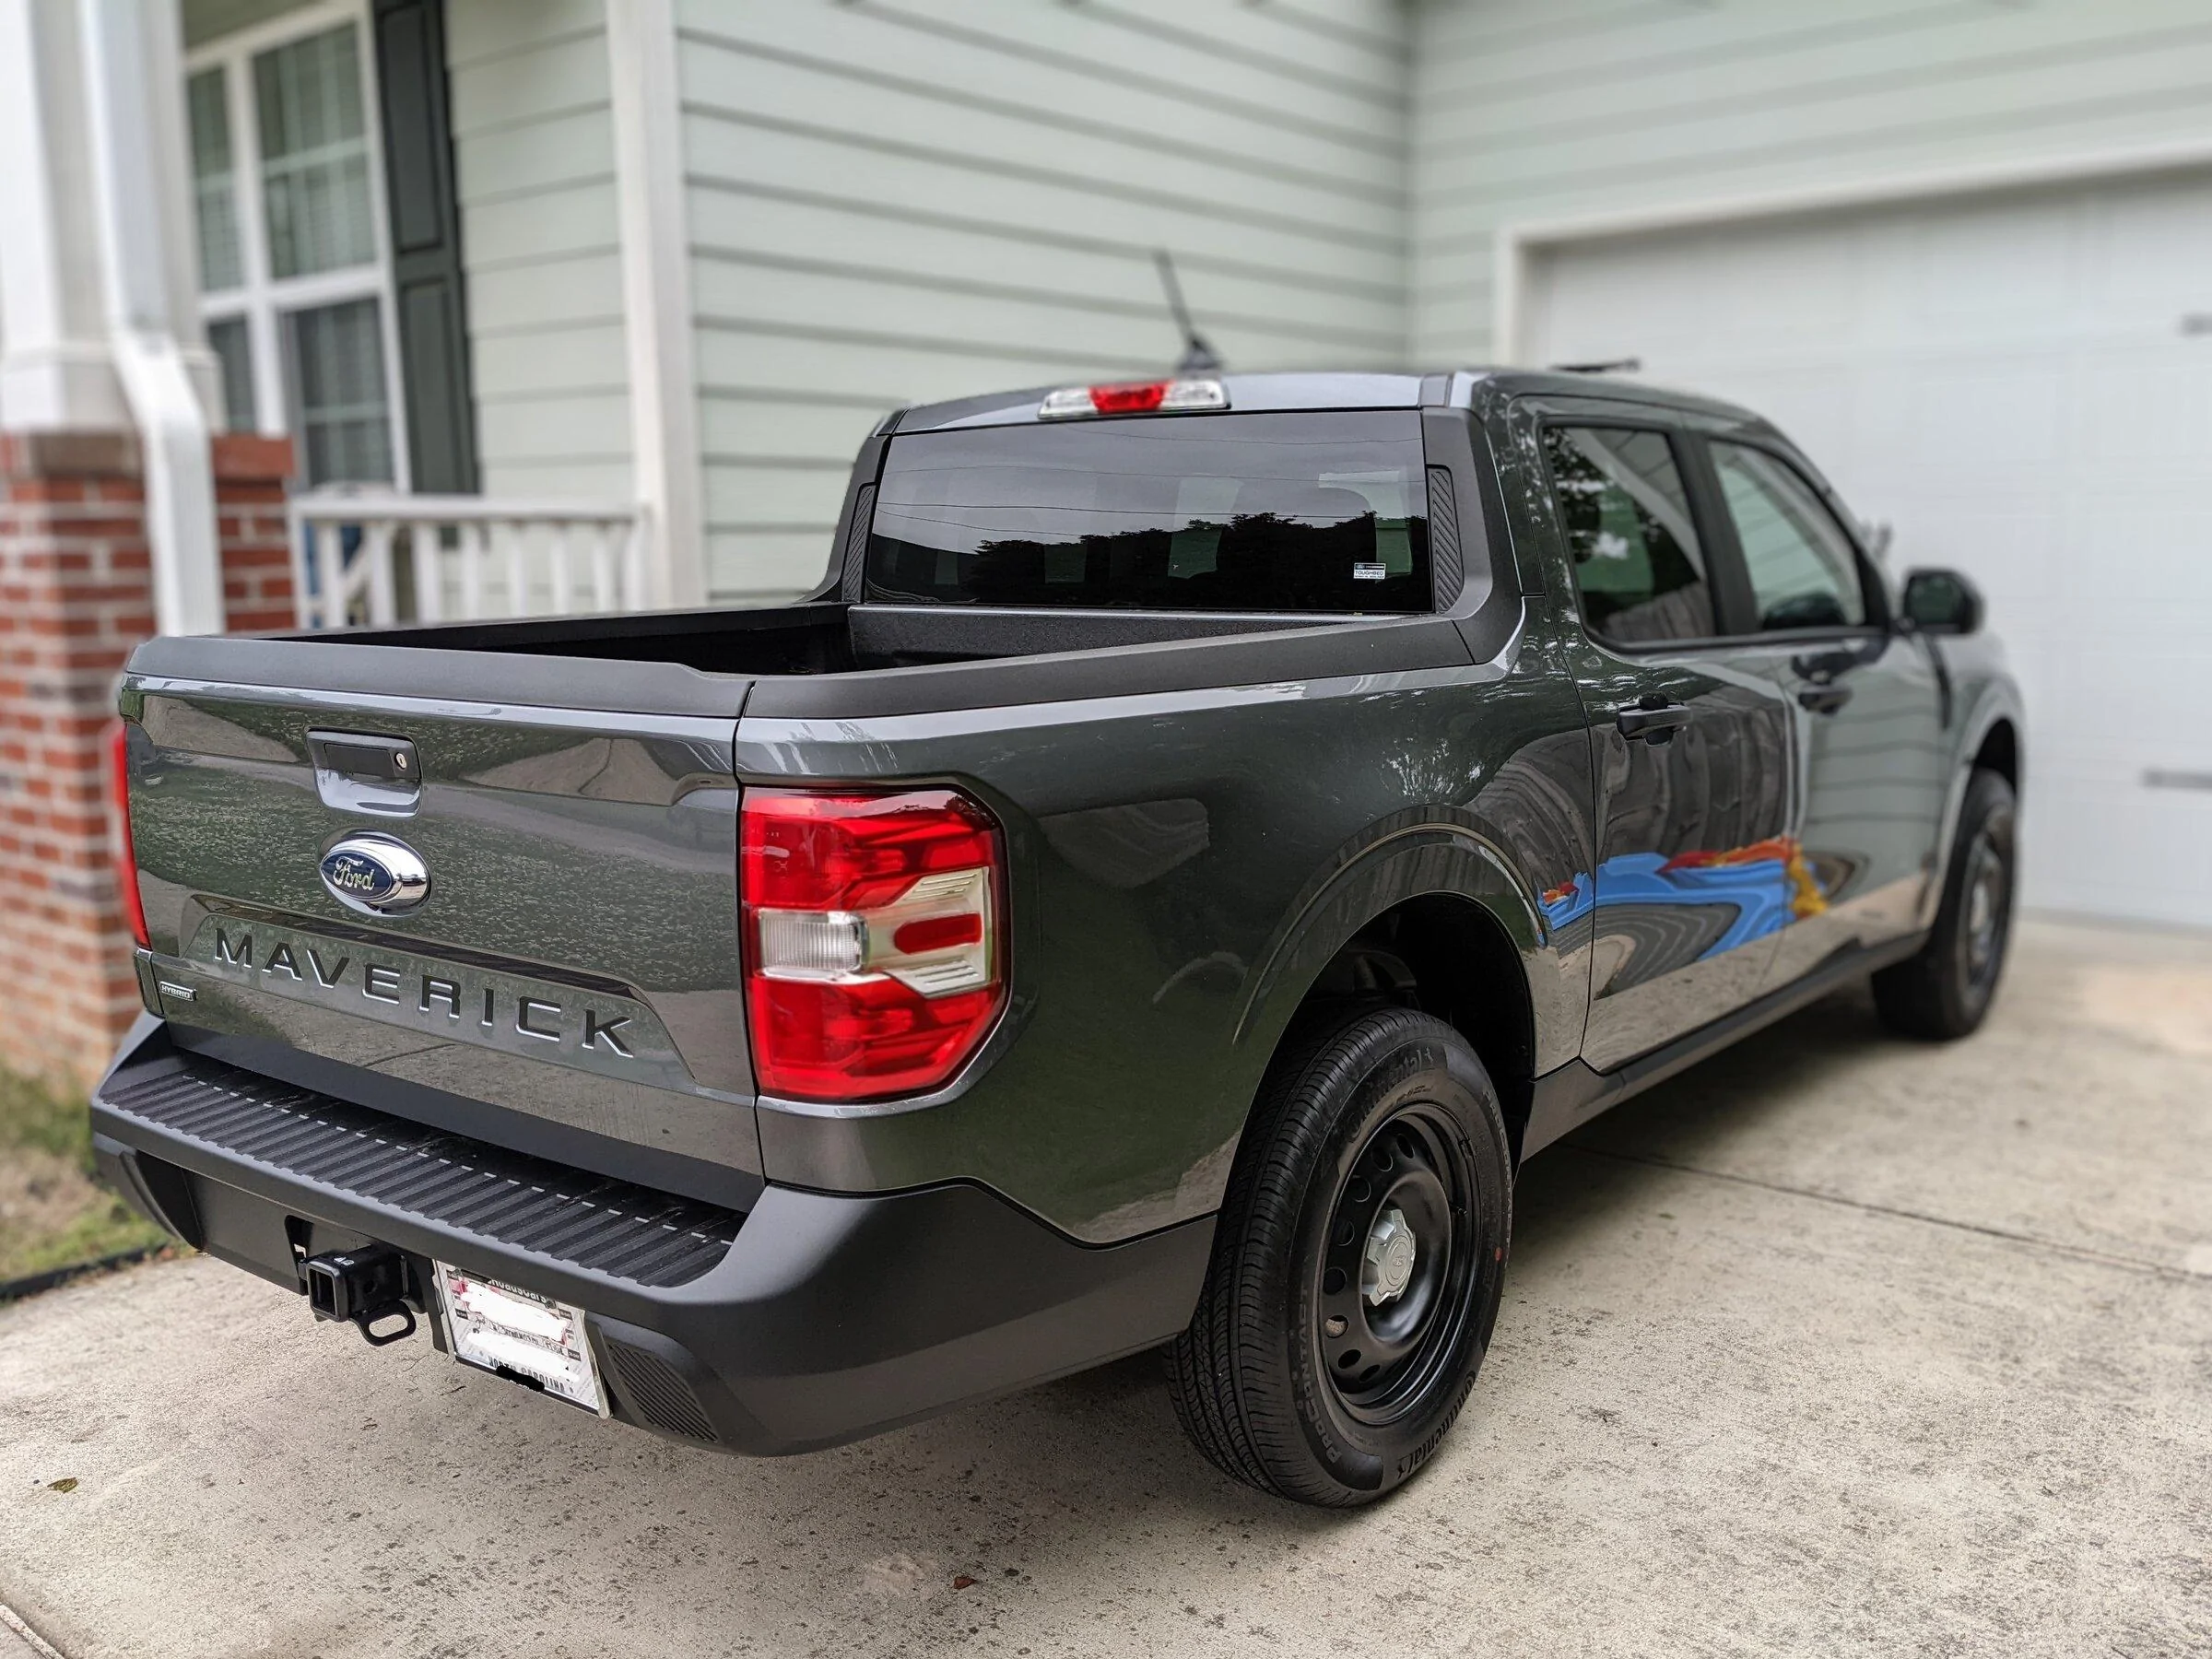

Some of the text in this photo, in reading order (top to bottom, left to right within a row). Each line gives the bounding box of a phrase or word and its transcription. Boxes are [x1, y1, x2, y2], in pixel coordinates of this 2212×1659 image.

[333, 855, 375, 891] Ford
[161, 984, 192, 999] HYBRID
[214, 927, 633, 1058] MAVERICK
